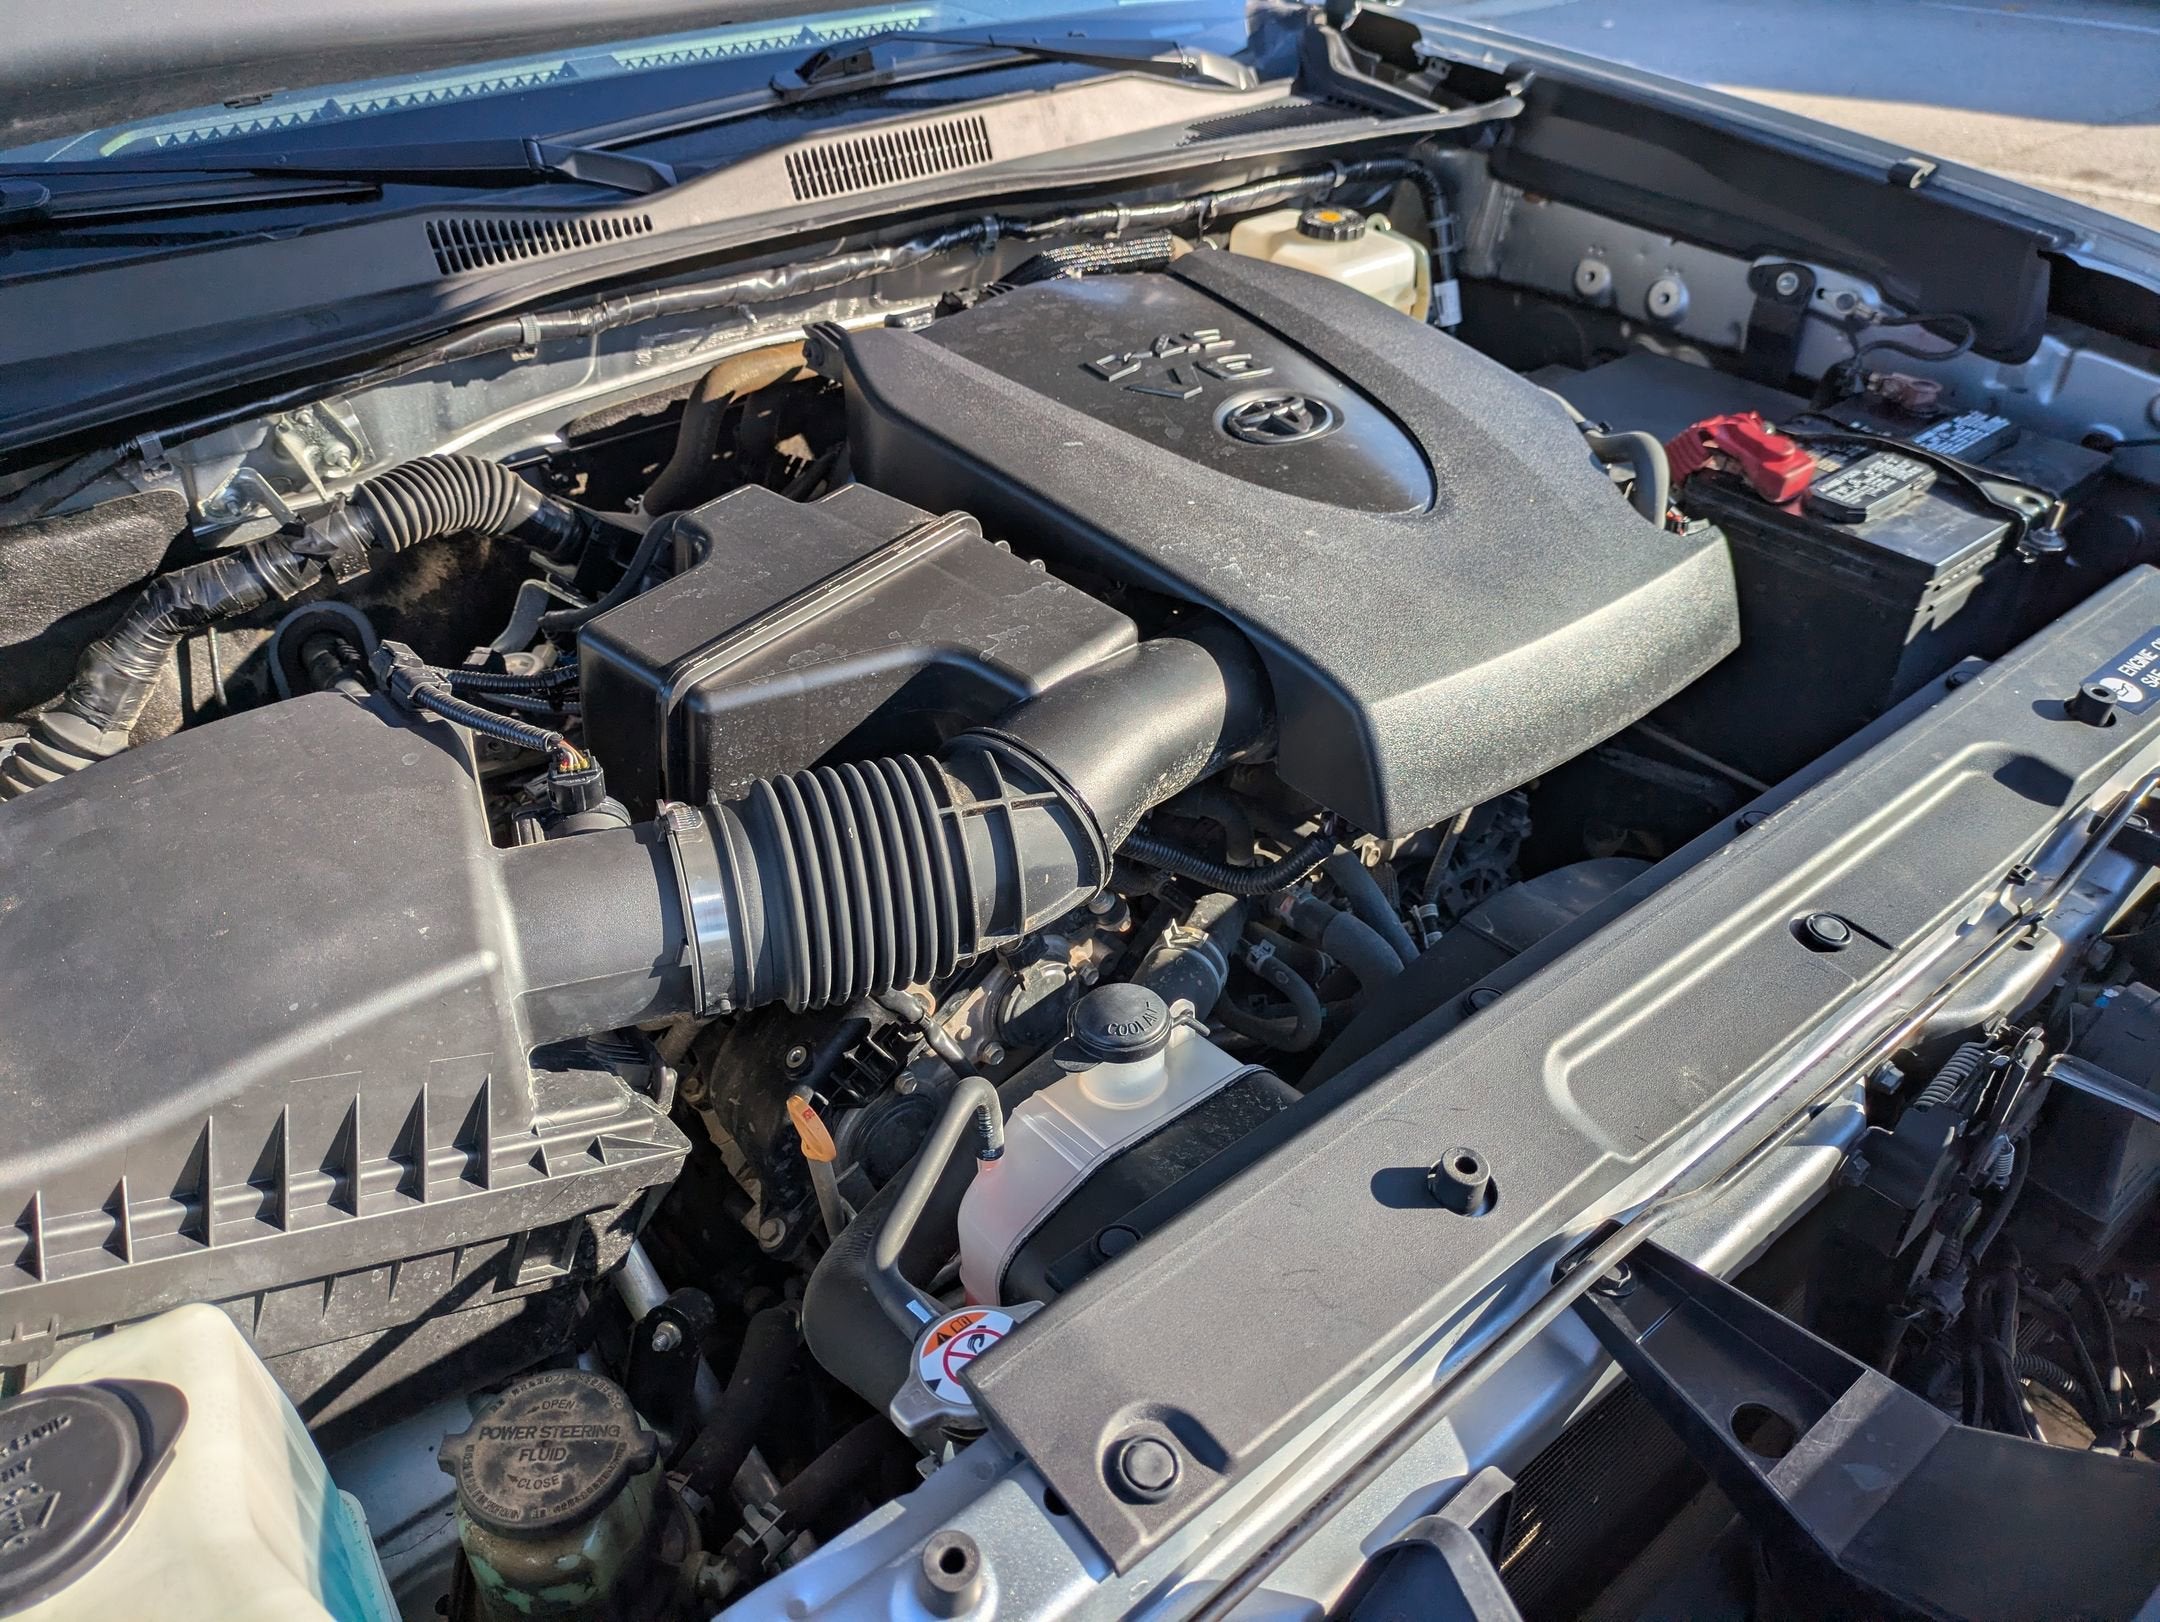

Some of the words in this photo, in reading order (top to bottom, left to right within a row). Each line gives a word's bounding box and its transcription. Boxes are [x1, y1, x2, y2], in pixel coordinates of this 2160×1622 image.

[1122, 353, 1275, 400] V6
[2117, 648, 2158, 677] ENGINE
[1106, 1001, 1158, 1037] COOLANT
[541, 1399, 576, 1411] OPEN
[478, 1425, 538, 1441] POWER
[539, 1424, 621, 1439] STEERING
[518, 1447, 567, 1462] FLUID
[517, 1474, 560, 1490] CLOSE
